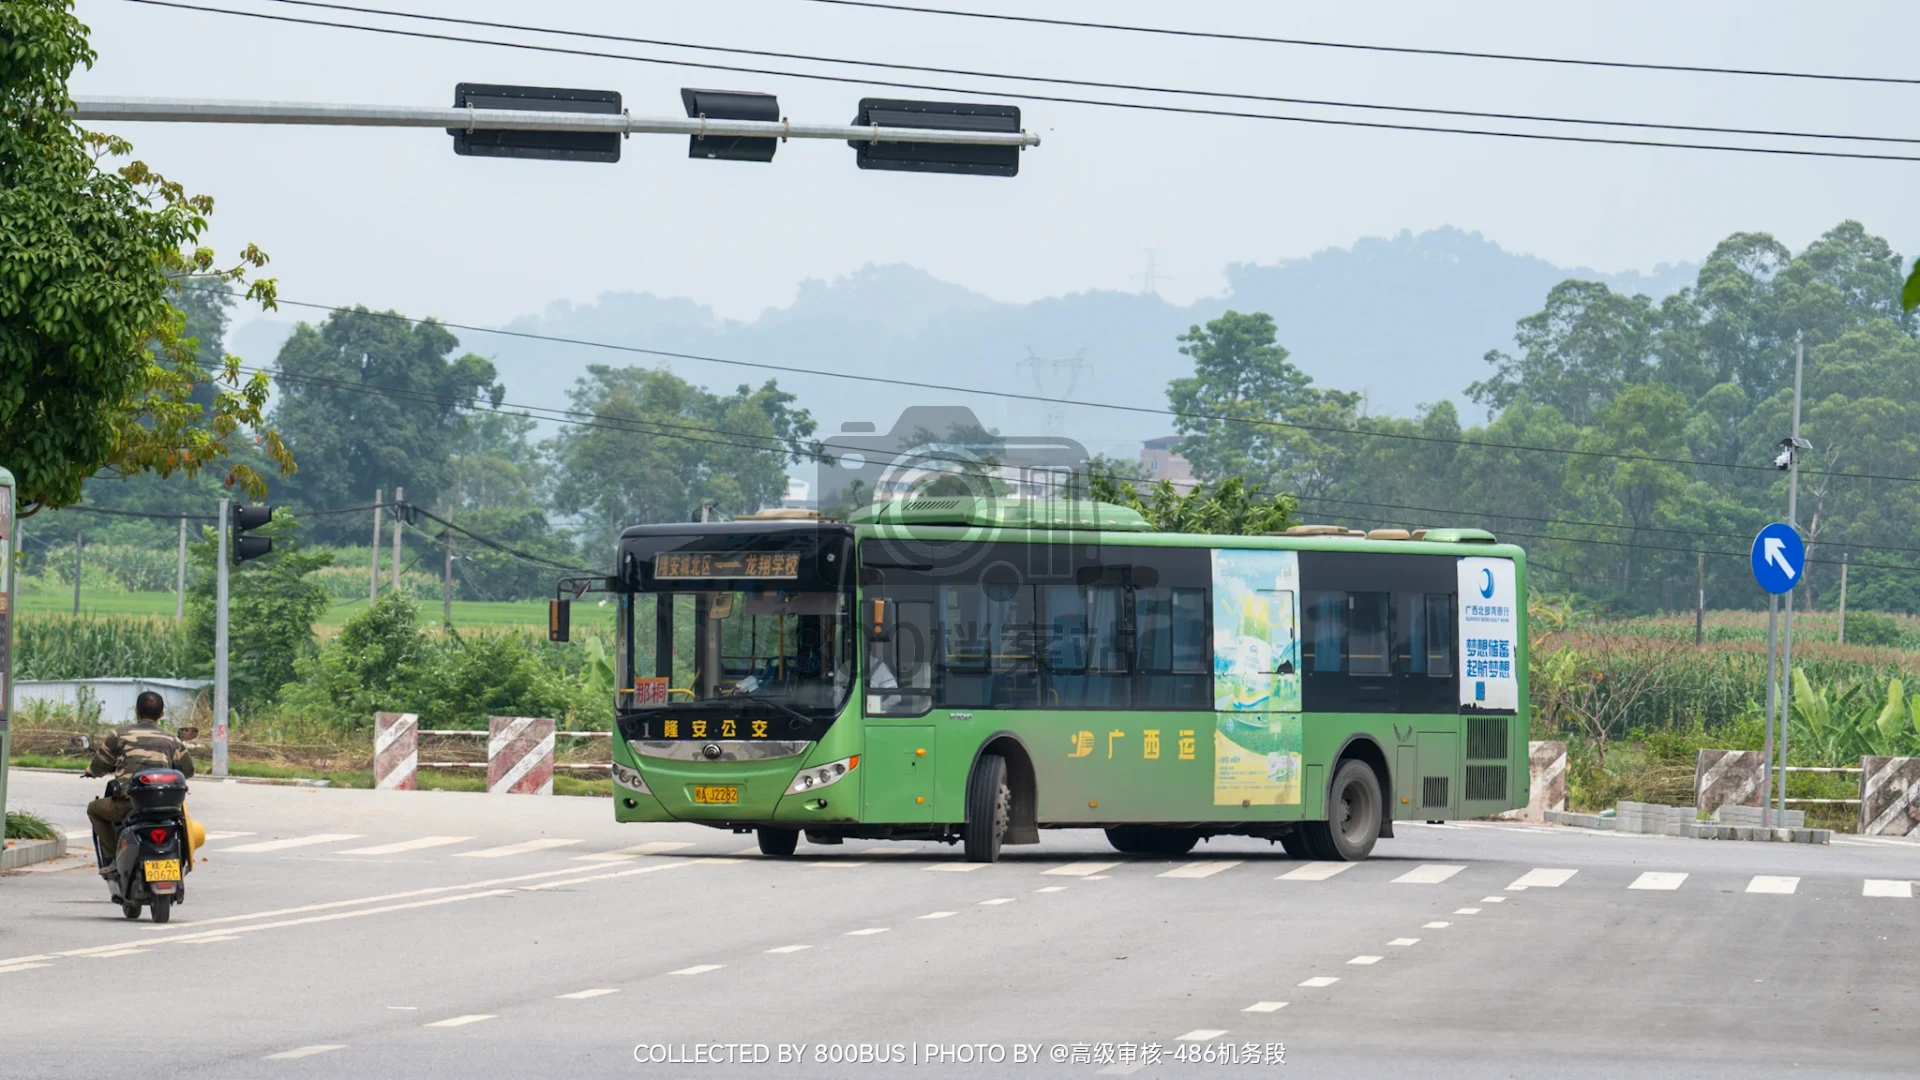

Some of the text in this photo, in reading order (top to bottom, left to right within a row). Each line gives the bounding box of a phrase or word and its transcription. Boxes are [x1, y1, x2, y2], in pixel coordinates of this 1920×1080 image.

[744, 554, 799, 576] 龙翔学校
[1466, 638, 1510, 658] 梦想储蓄
[1466, 659, 1510, 678] 起航梦想
[635, 683, 667, 704] 那桐
[642, 720, 768, 738] 1 隆安公交
